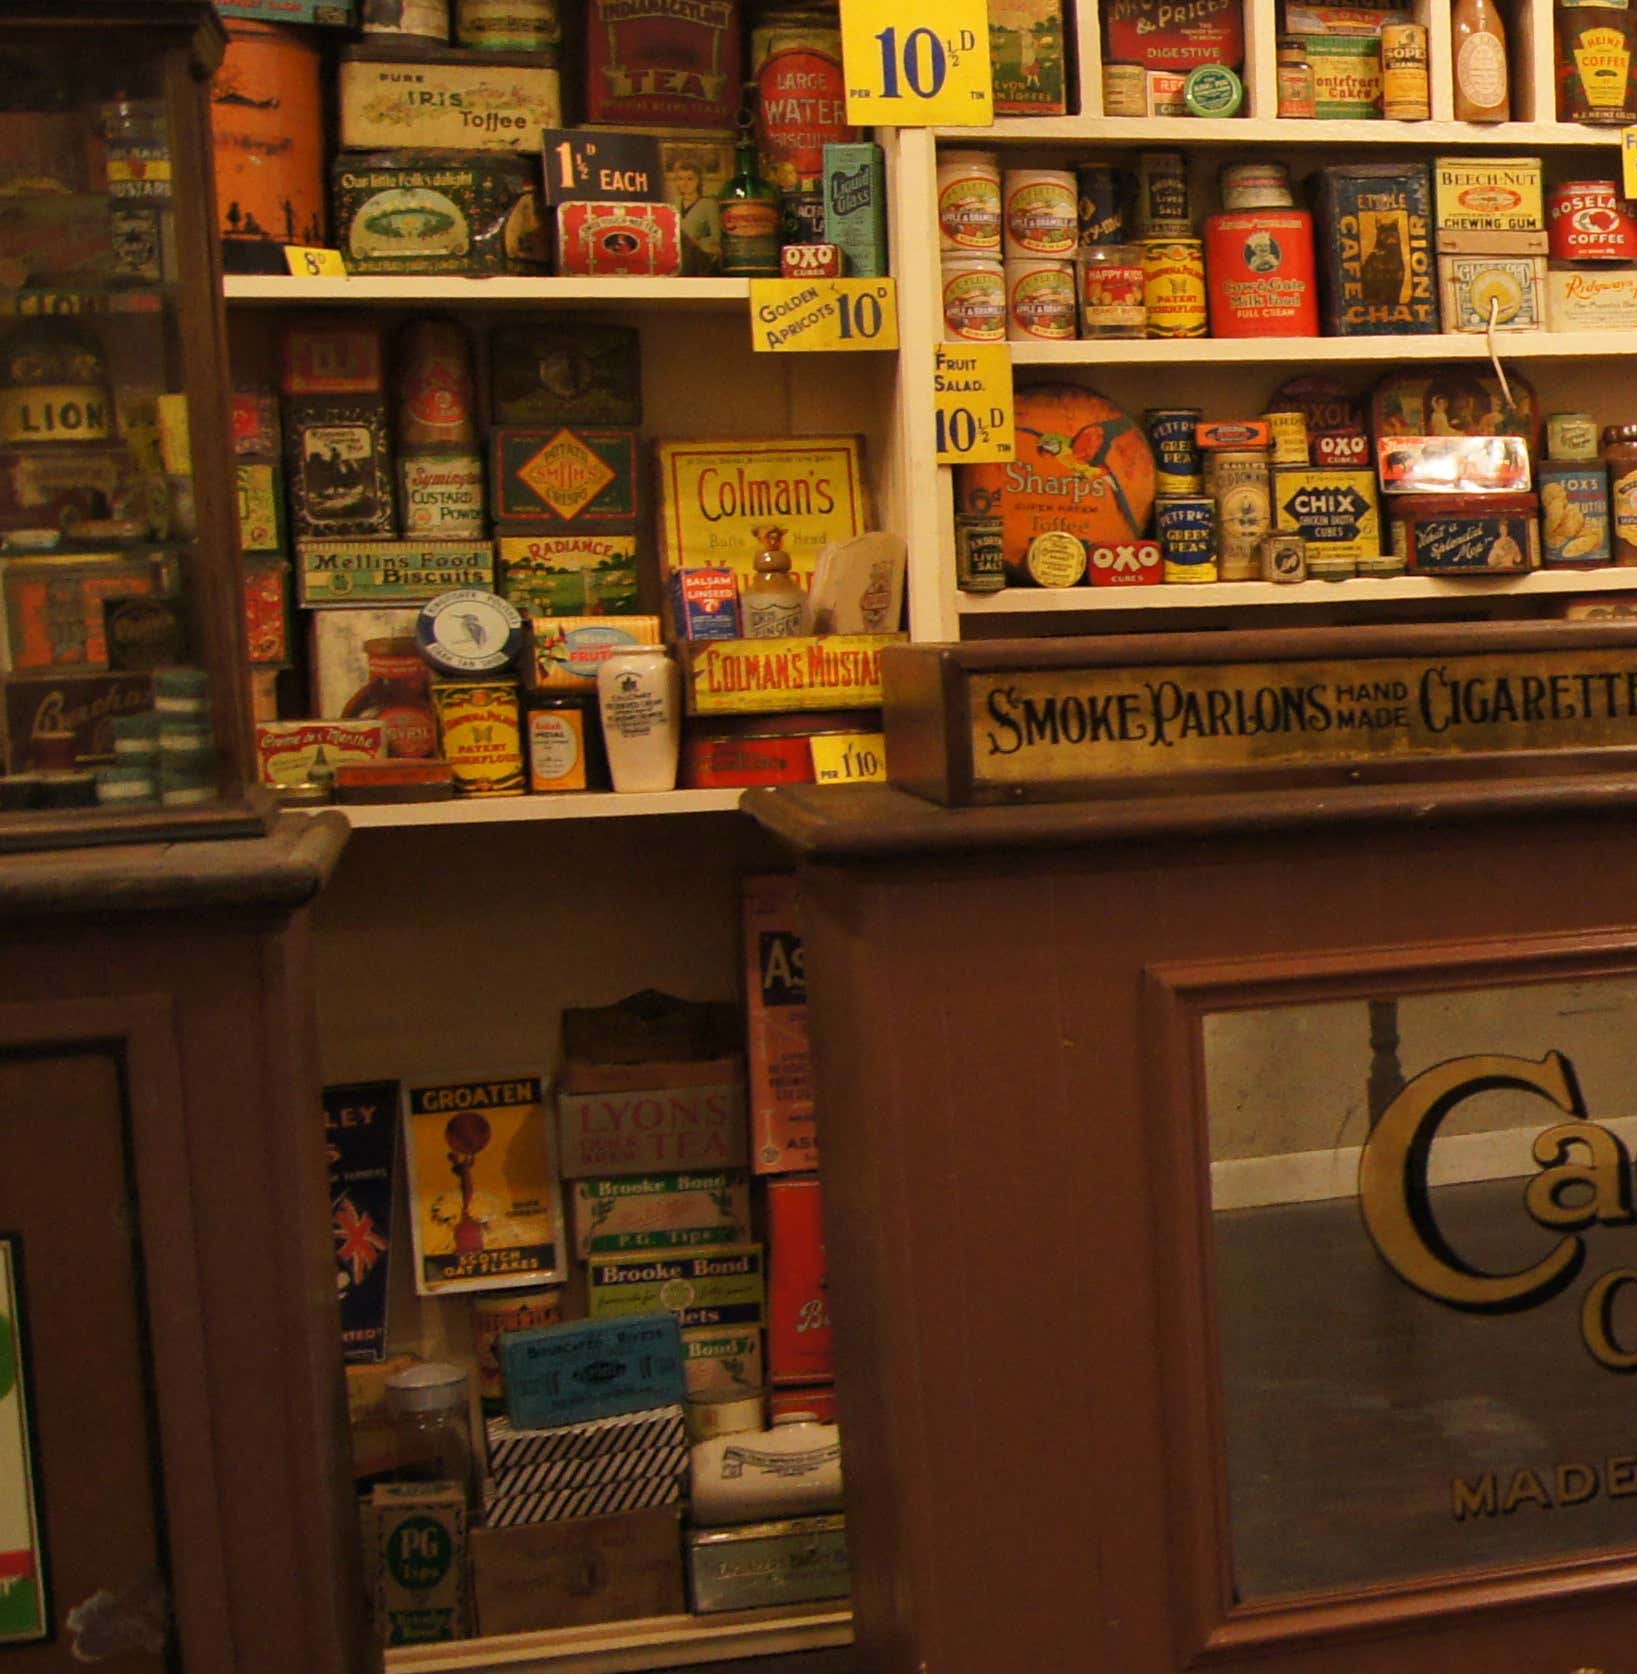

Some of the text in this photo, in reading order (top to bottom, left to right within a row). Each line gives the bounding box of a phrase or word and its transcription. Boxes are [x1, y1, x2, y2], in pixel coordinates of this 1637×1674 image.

[1146, 47, 1222, 59] DIGESTIVE
[1581, 54, 1627, 68] COFFEE
[776, 72, 828, 91] LARGE
[408, 90, 464, 108] IRIS
[460, 110, 528, 132] Toffee
[764, 99, 846, 126] WATER
[600, 170, 648, 193] EACH
[1443, 217, 1537, 230] CHEWING GUM
[1567, 232, 1625, 245] COFFEE
[785, 248, 833, 269] OXO
[1338, 215, 1363, 297] CAFE
[1409, 215, 1428, 298] NOIR
[758, 286, 819, 325] GOLDEN
[1346, 303, 1431, 325] CHAT
[765, 303, 836, 350] APRICOTS
[935, 353, 977, 371] FRUIT
[1320, 437, 1365, 456] OXO
[698, 466, 835, 522] Colman's
[1294, 493, 1356, 514] CHIX
[420, 551, 480, 568] Food
[528, 540, 614, 564] RADIANCE
[1093, 546, 1160, 572] OXO
[383, 568, 484, 585] Biscuits
[708, 646, 802, 693] COLMAN'S
[1335, 680, 1410, 703] HAND
[987, 684, 1147, 757] SMOKE
[1335, 705, 1411, 730] MADE
[579, 1094, 730, 1136] LYONS
[651, 1131, 730, 1161] TEA
[459, 1250, 522, 1265] SCOTCH
[602, 1256, 750, 1285] Brooke Bond
[399, 1530, 440, 1560] PG
